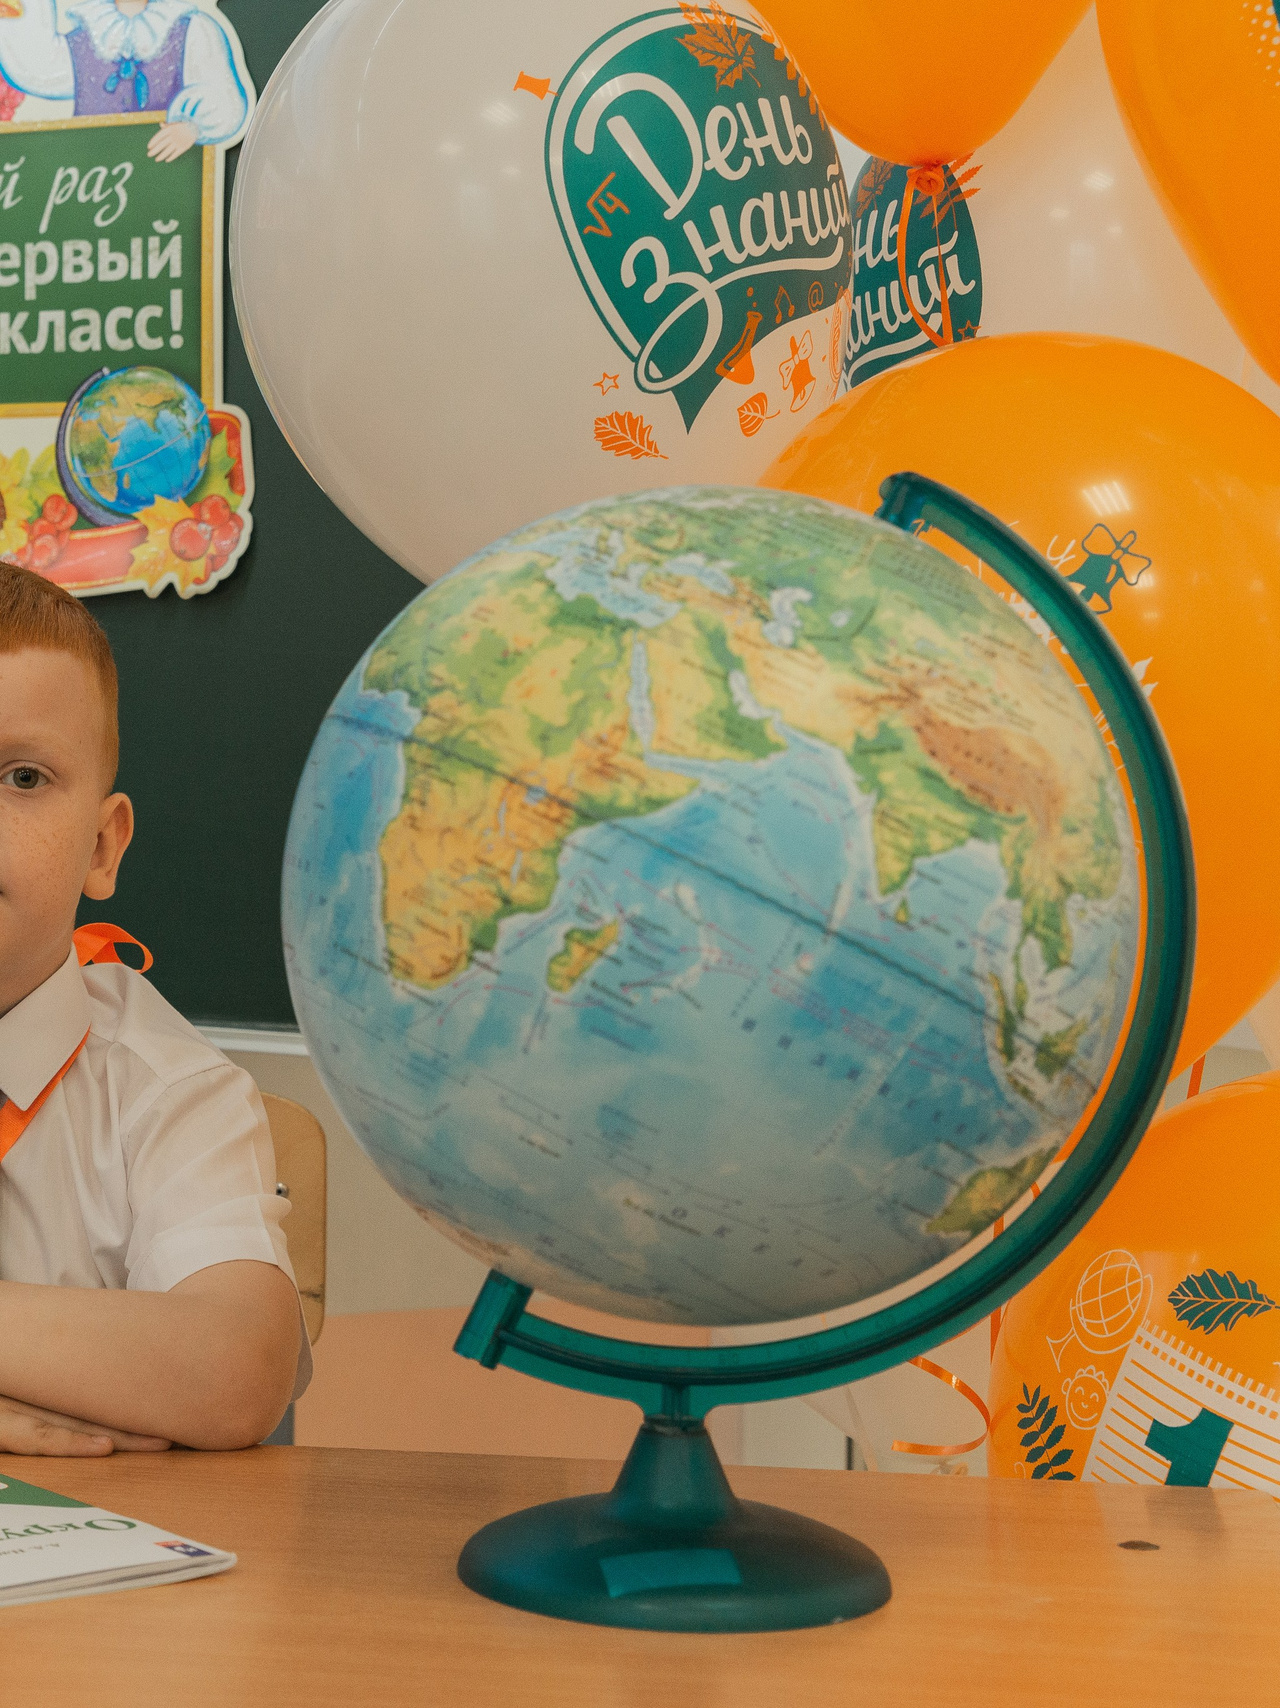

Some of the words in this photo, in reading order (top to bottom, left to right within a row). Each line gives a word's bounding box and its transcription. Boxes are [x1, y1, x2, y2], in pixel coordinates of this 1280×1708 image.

[39, 160, 135, 233] раз
[574, 71, 814, 221] День
[621, 158, 852, 391] Знаний
